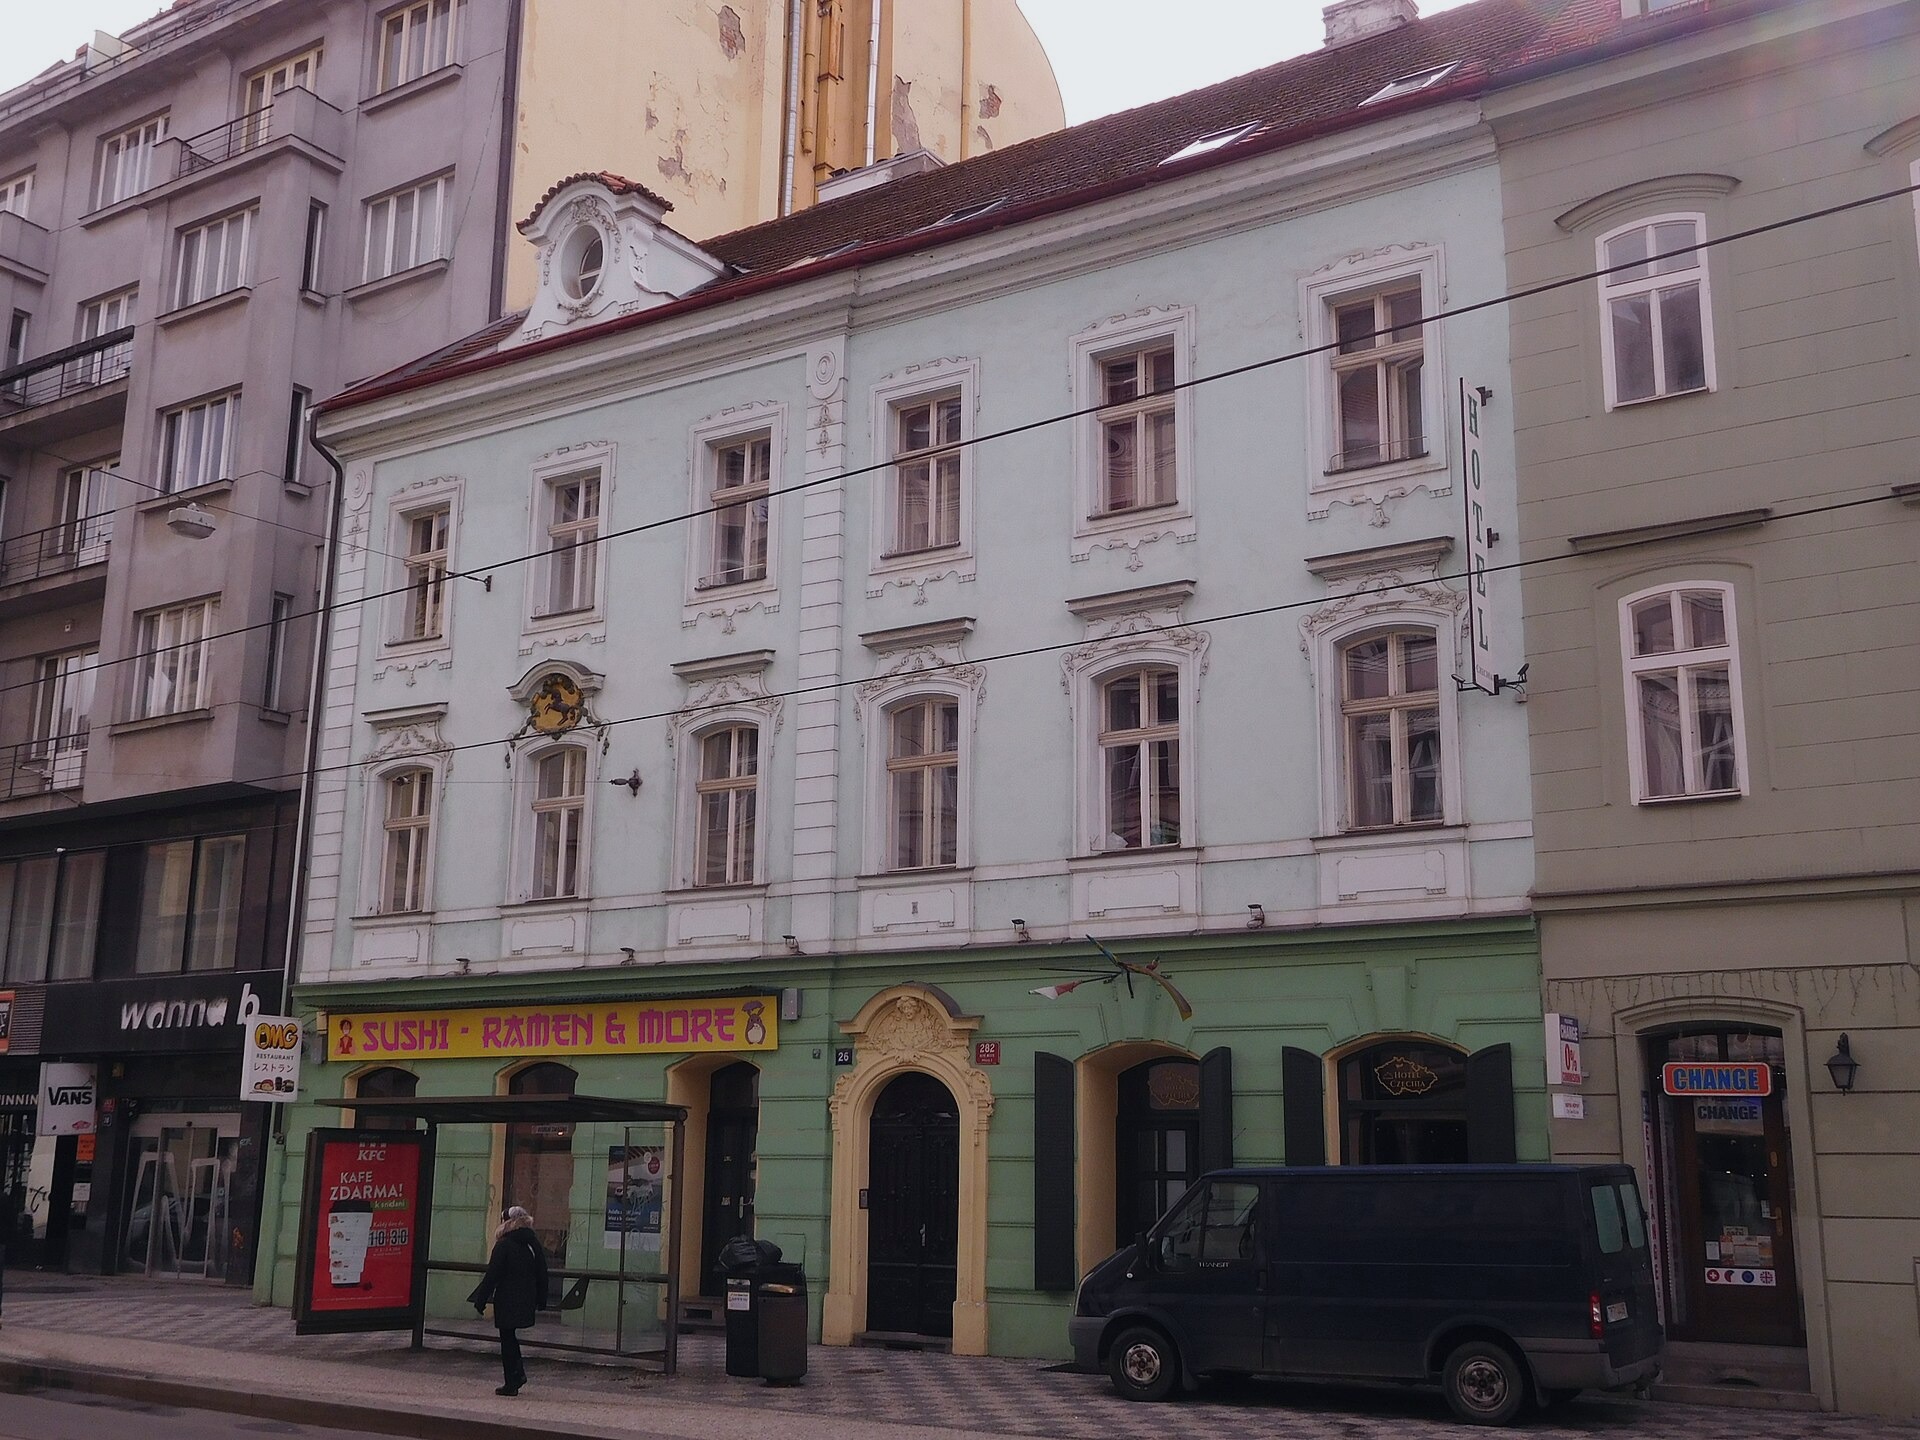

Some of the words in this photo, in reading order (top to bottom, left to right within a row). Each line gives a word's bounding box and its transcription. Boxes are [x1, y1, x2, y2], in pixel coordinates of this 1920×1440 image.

[1466, 393, 1489, 652] HOTEL
[121, 998, 228, 1030] wanna
[255, 1022, 299, 1050] OMG
[362, 1018, 450, 1051] SUSHI
[483, 1011, 594, 1048] RAMEN
[605, 1012, 626, 1044] &
[639, 1007, 735, 1044] MORE
[979, 1043, 995, 1053] 282
[256, 1053, 295, 1061] RESTAURANT
[838, 1051, 849, 1062] 26
[1564, 1043, 1577, 1072] 0%
[254, 1062, 294, 1073] レストラン
[1394, 1071, 1421, 1079] HOTEL
[1673, 1068, 1760, 1091] CHANGE
[48, 1086, 93, 1106] VANS
[1697, 1105, 1758, 1120] CHANGE
[357, 1149, 386, 1161] KFC
[340, 1171, 373, 1184] KAFE
[329, 1184, 404, 1200] ZDARMA!
[369, 1229, 407, 1246] 10:30
